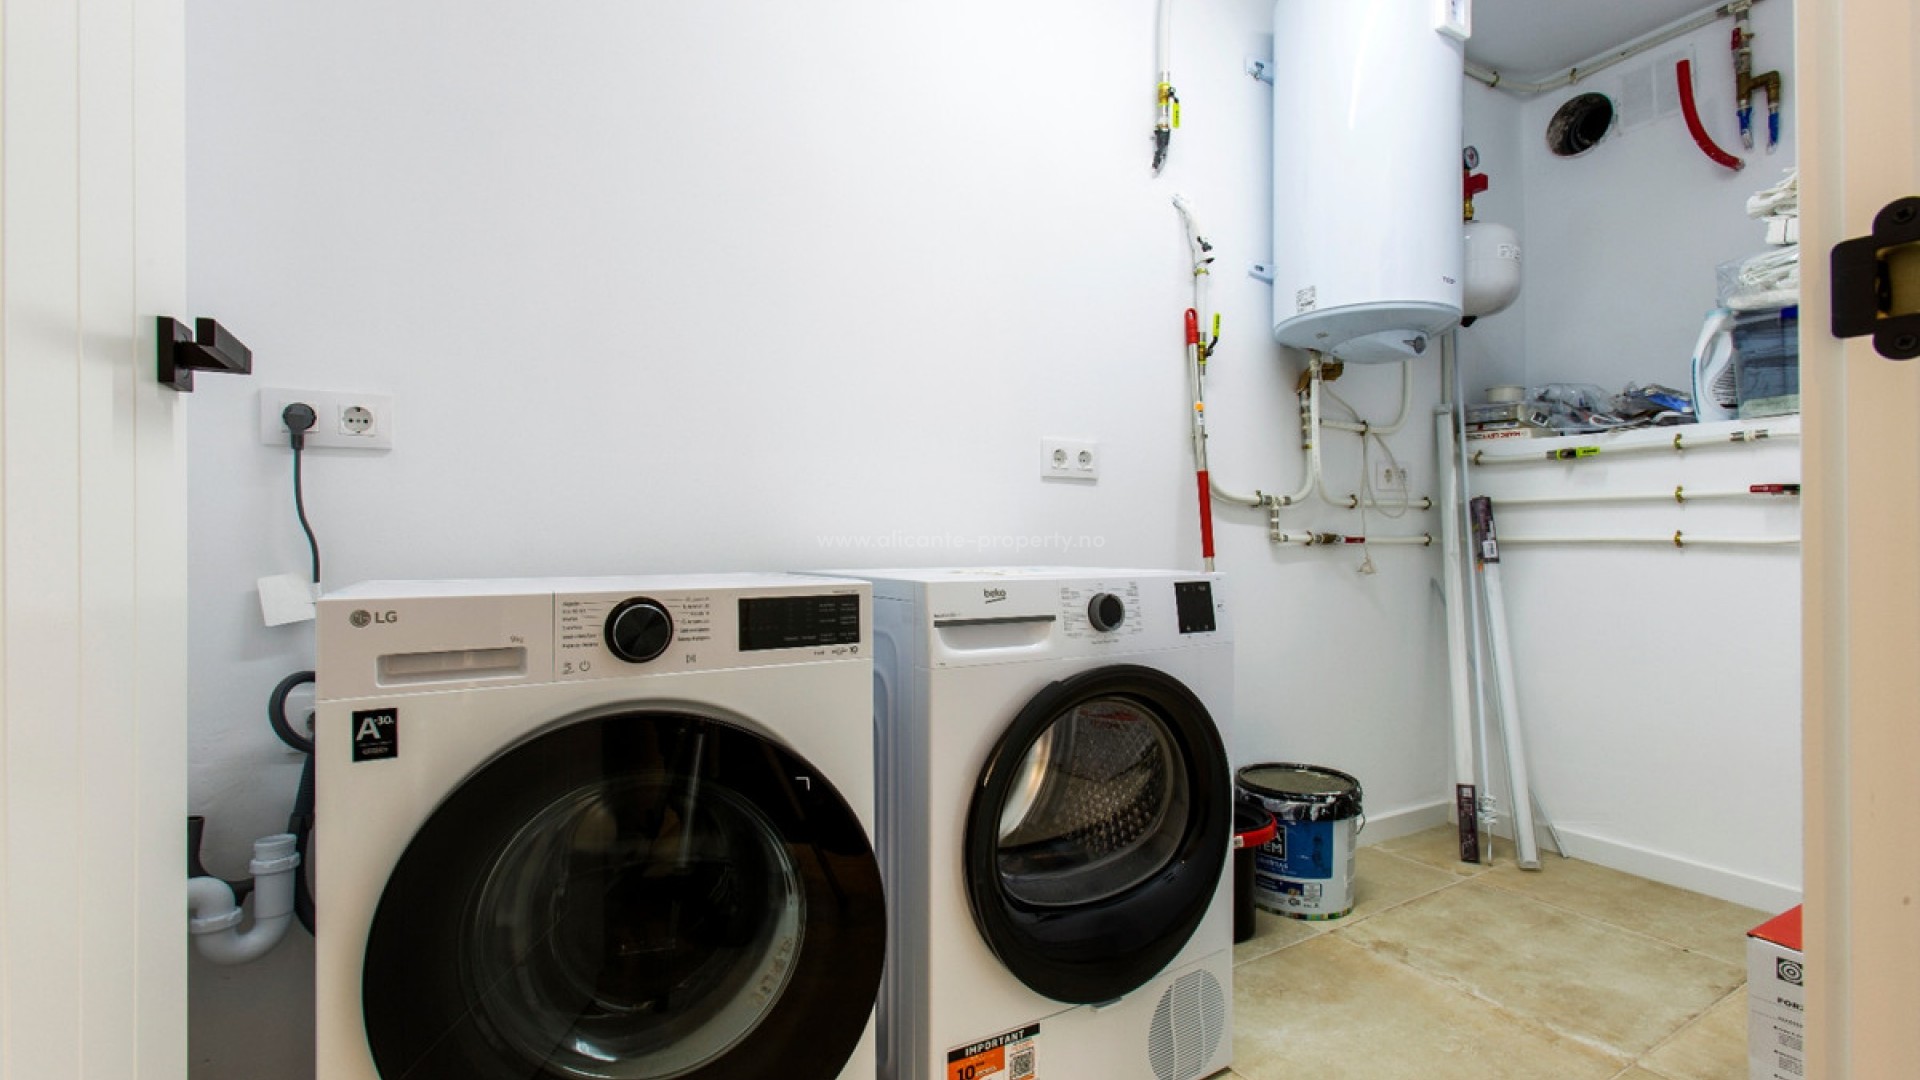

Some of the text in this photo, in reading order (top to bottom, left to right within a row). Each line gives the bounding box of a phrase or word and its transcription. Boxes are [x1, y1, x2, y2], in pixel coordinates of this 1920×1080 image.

[983, 587, 1007, 599] beko
[374, 610, 398, 625] LG
[964, 1029, 1024, 1057] IMPORTANT
